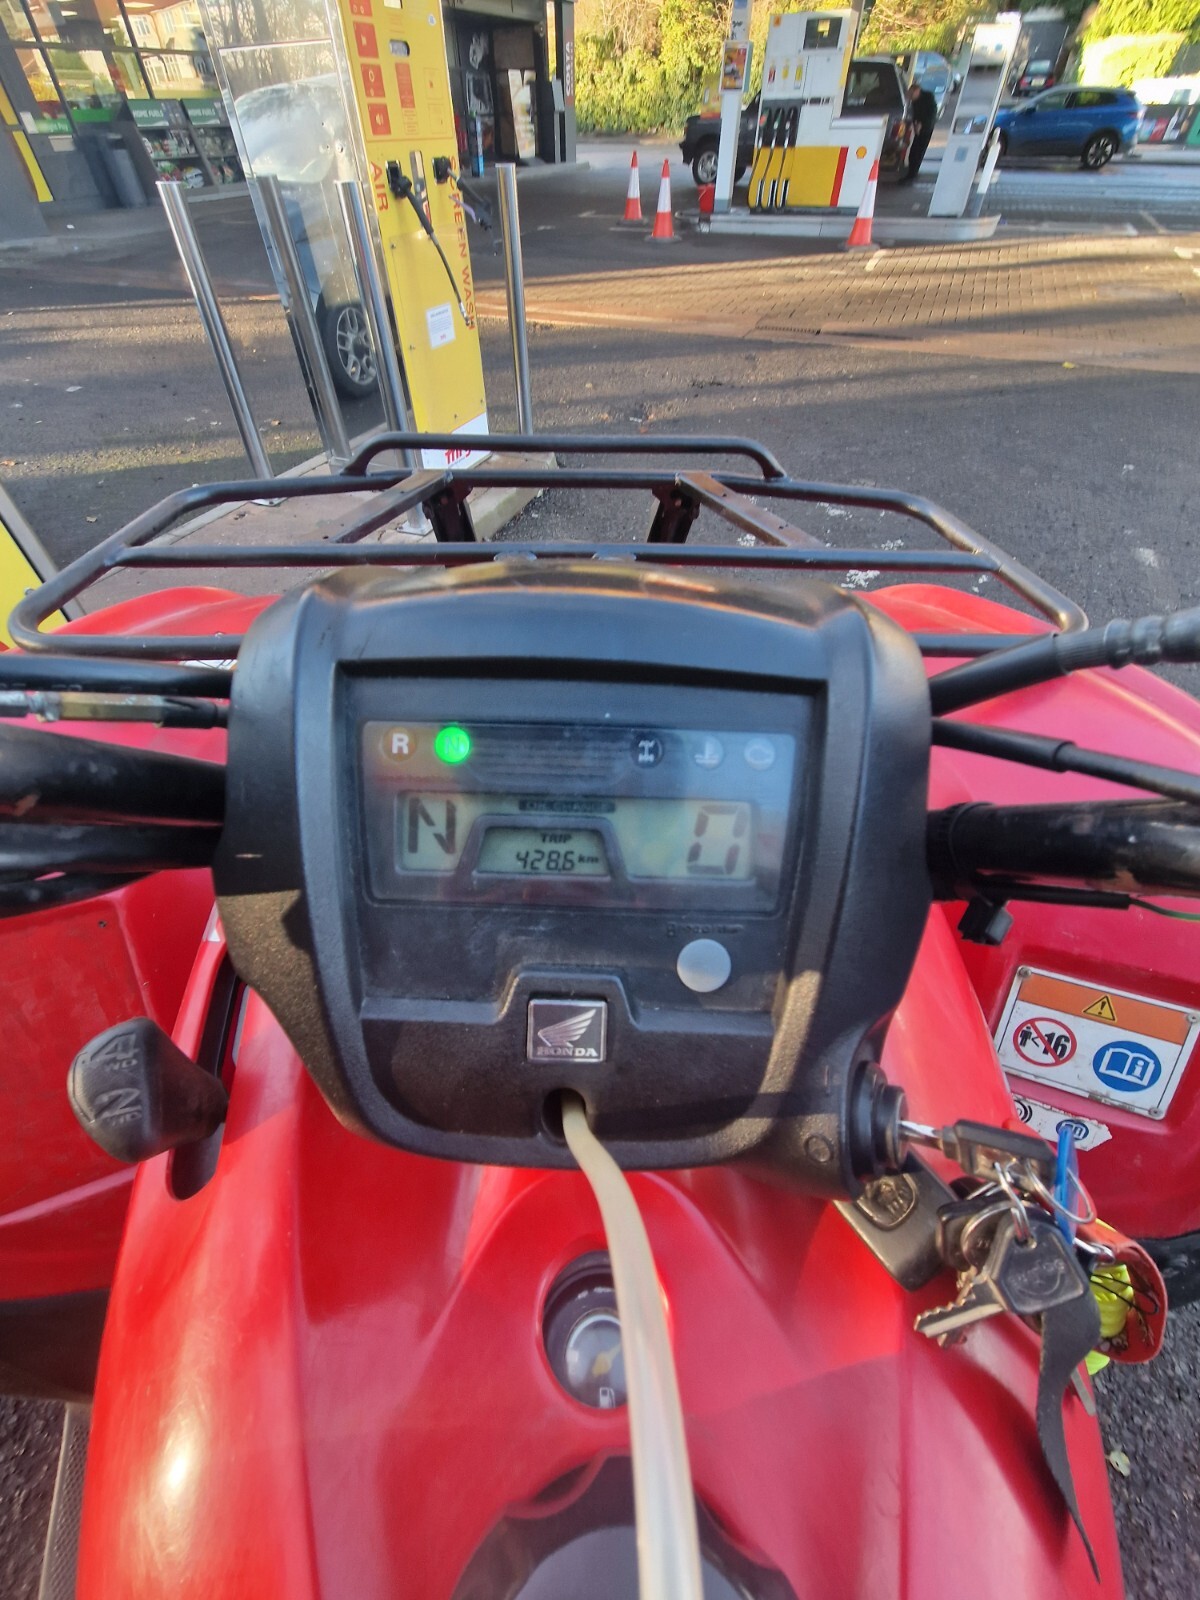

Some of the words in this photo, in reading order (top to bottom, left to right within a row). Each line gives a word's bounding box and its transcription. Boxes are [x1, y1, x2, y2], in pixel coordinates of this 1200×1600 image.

[370, 160, 389, 211] AIR
[391, 732, 410, 755] R
[407, 797, 457, 854] N
[541, 832, 572, 844] TRIP
[536, 1046, 599, 1057] HONDA
